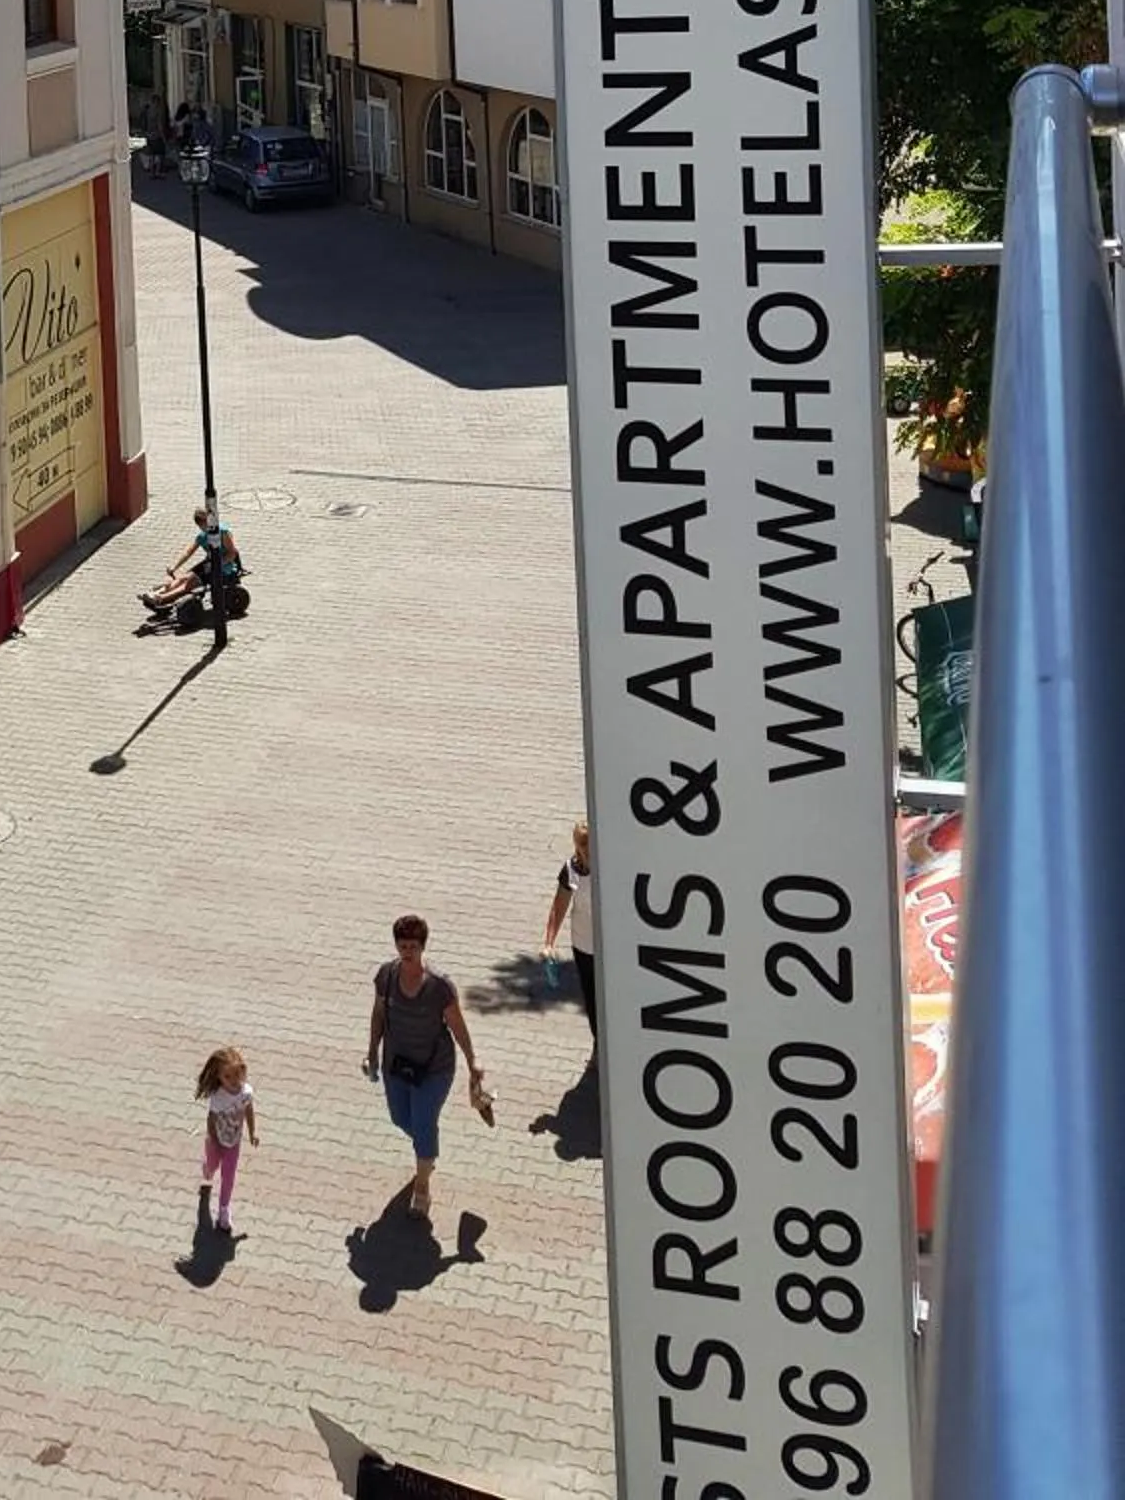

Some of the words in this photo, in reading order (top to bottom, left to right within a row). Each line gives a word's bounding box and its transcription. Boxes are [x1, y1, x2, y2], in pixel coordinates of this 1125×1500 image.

[3, 258, 78, 365] Vito
[630, 759, 722, 837] &
[762, 874, 854, 1004] 20
[634, 873, 740, 1302] ROOMS
[767, 1041, 859, 1170] 20
[773, 1206, 865, 1334] 88
[779, 1365, 871, 1500] 96
